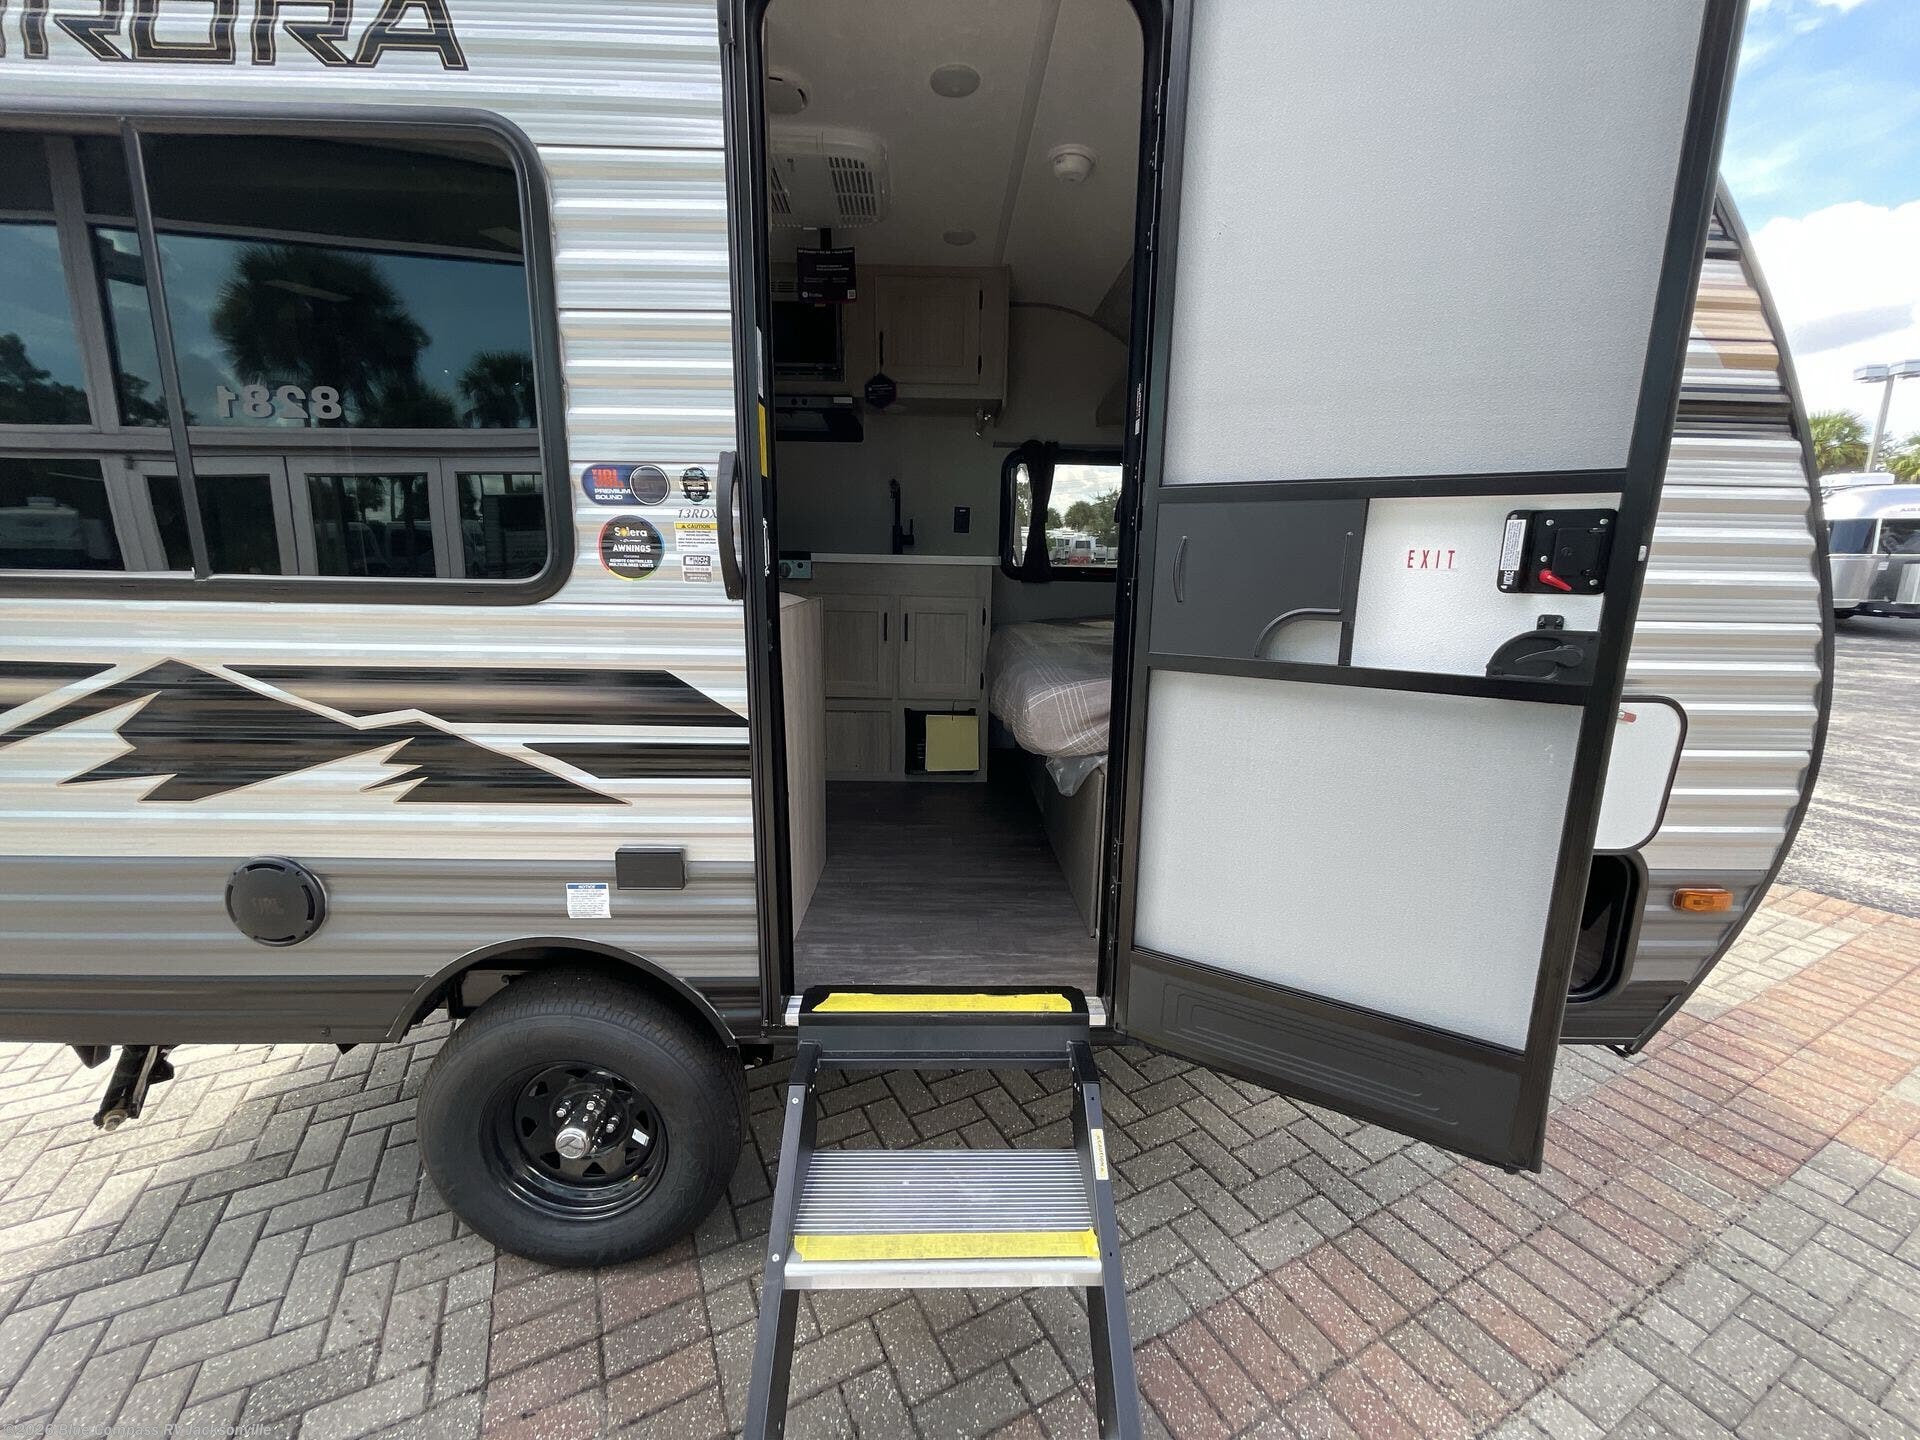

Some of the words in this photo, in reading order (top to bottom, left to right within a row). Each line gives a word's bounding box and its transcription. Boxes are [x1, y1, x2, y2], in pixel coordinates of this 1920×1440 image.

[0, 0, 469, 71] RORA
[614, 526, 648, 537] Solera
[612, 544, 651, 553] AWNINGS
[1407, 549, 1456, 569] EXIT
